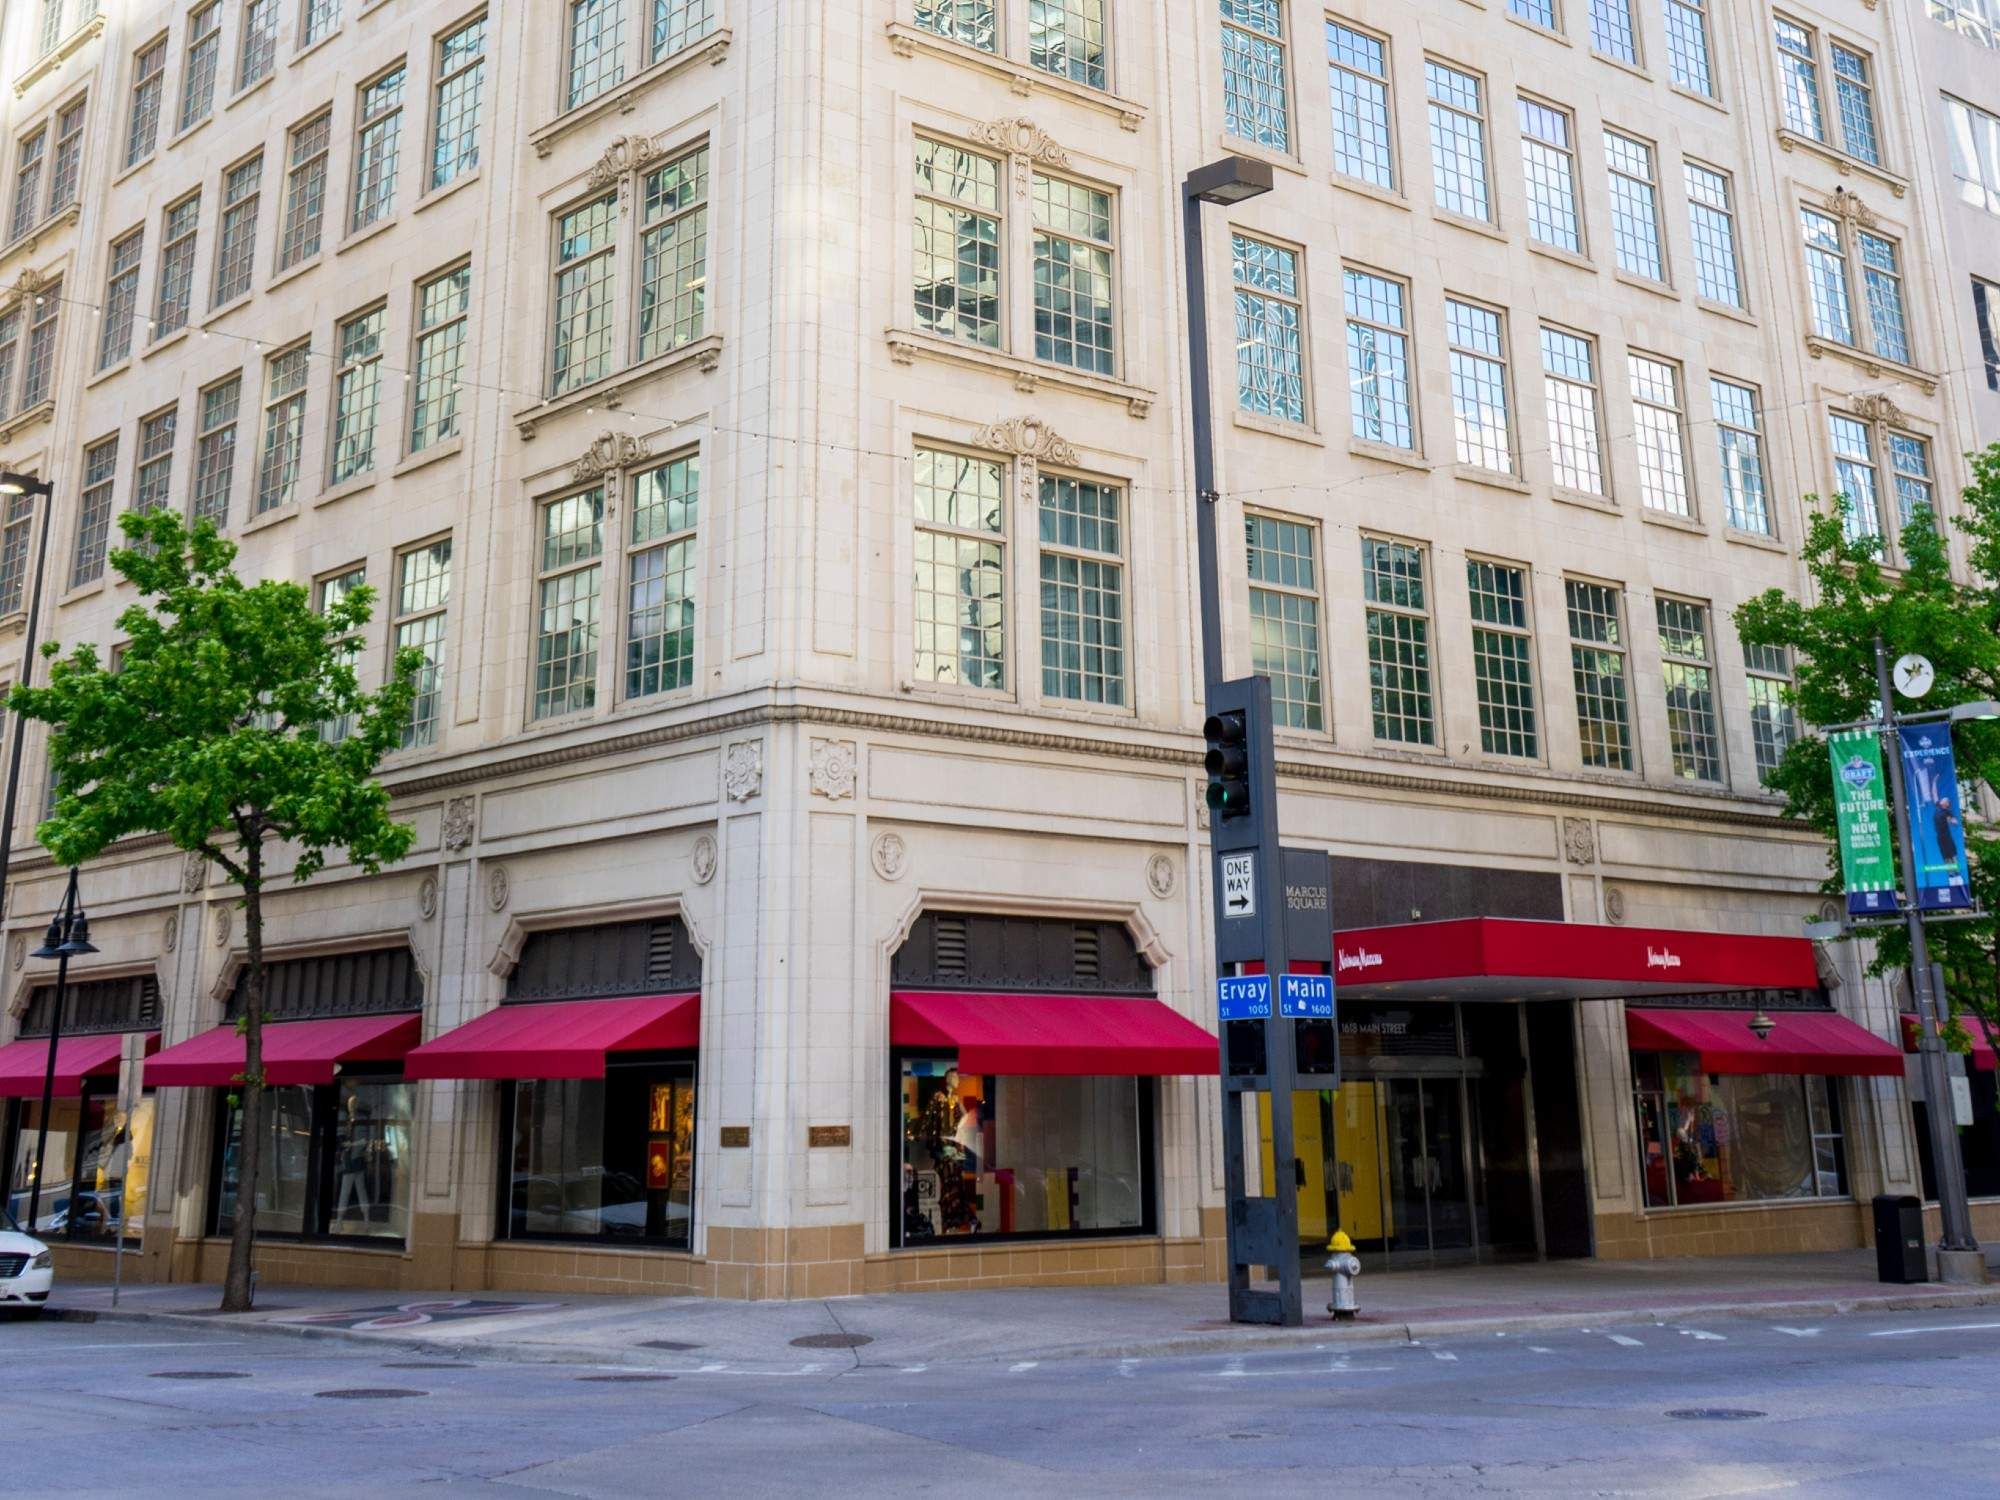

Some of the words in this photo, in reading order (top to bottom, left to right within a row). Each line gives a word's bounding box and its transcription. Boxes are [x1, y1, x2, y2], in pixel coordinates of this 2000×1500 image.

[1844, 769, 1873, 779] DRAFT
[1850, 790, 1872, 800] THE
[1840, 800, 1884, 813] FUTURE
[1858, 812, 1869, 823] IS
[1852, 823, 1877, 834] NOW
[1226, 860, 1250, 876] ONE
[1227, 878, 1250, 892] WAY
[1286, 886, 1327, 898] MARCUS
[1288, 898, 1327, 909] SQUARE
[1220, 983, 1267, 1002] Ervay
[1287, 979, 1326, 998] Main
[1221, 1007, 1230, 1016] St
[1283, 1003, 1292, 1014] St
[1311, 1004, 1331, 1014] 1600
[1359, 1023, 1380, 1033] MAIN
[1381, 1023, 1406, 1034] STREET
